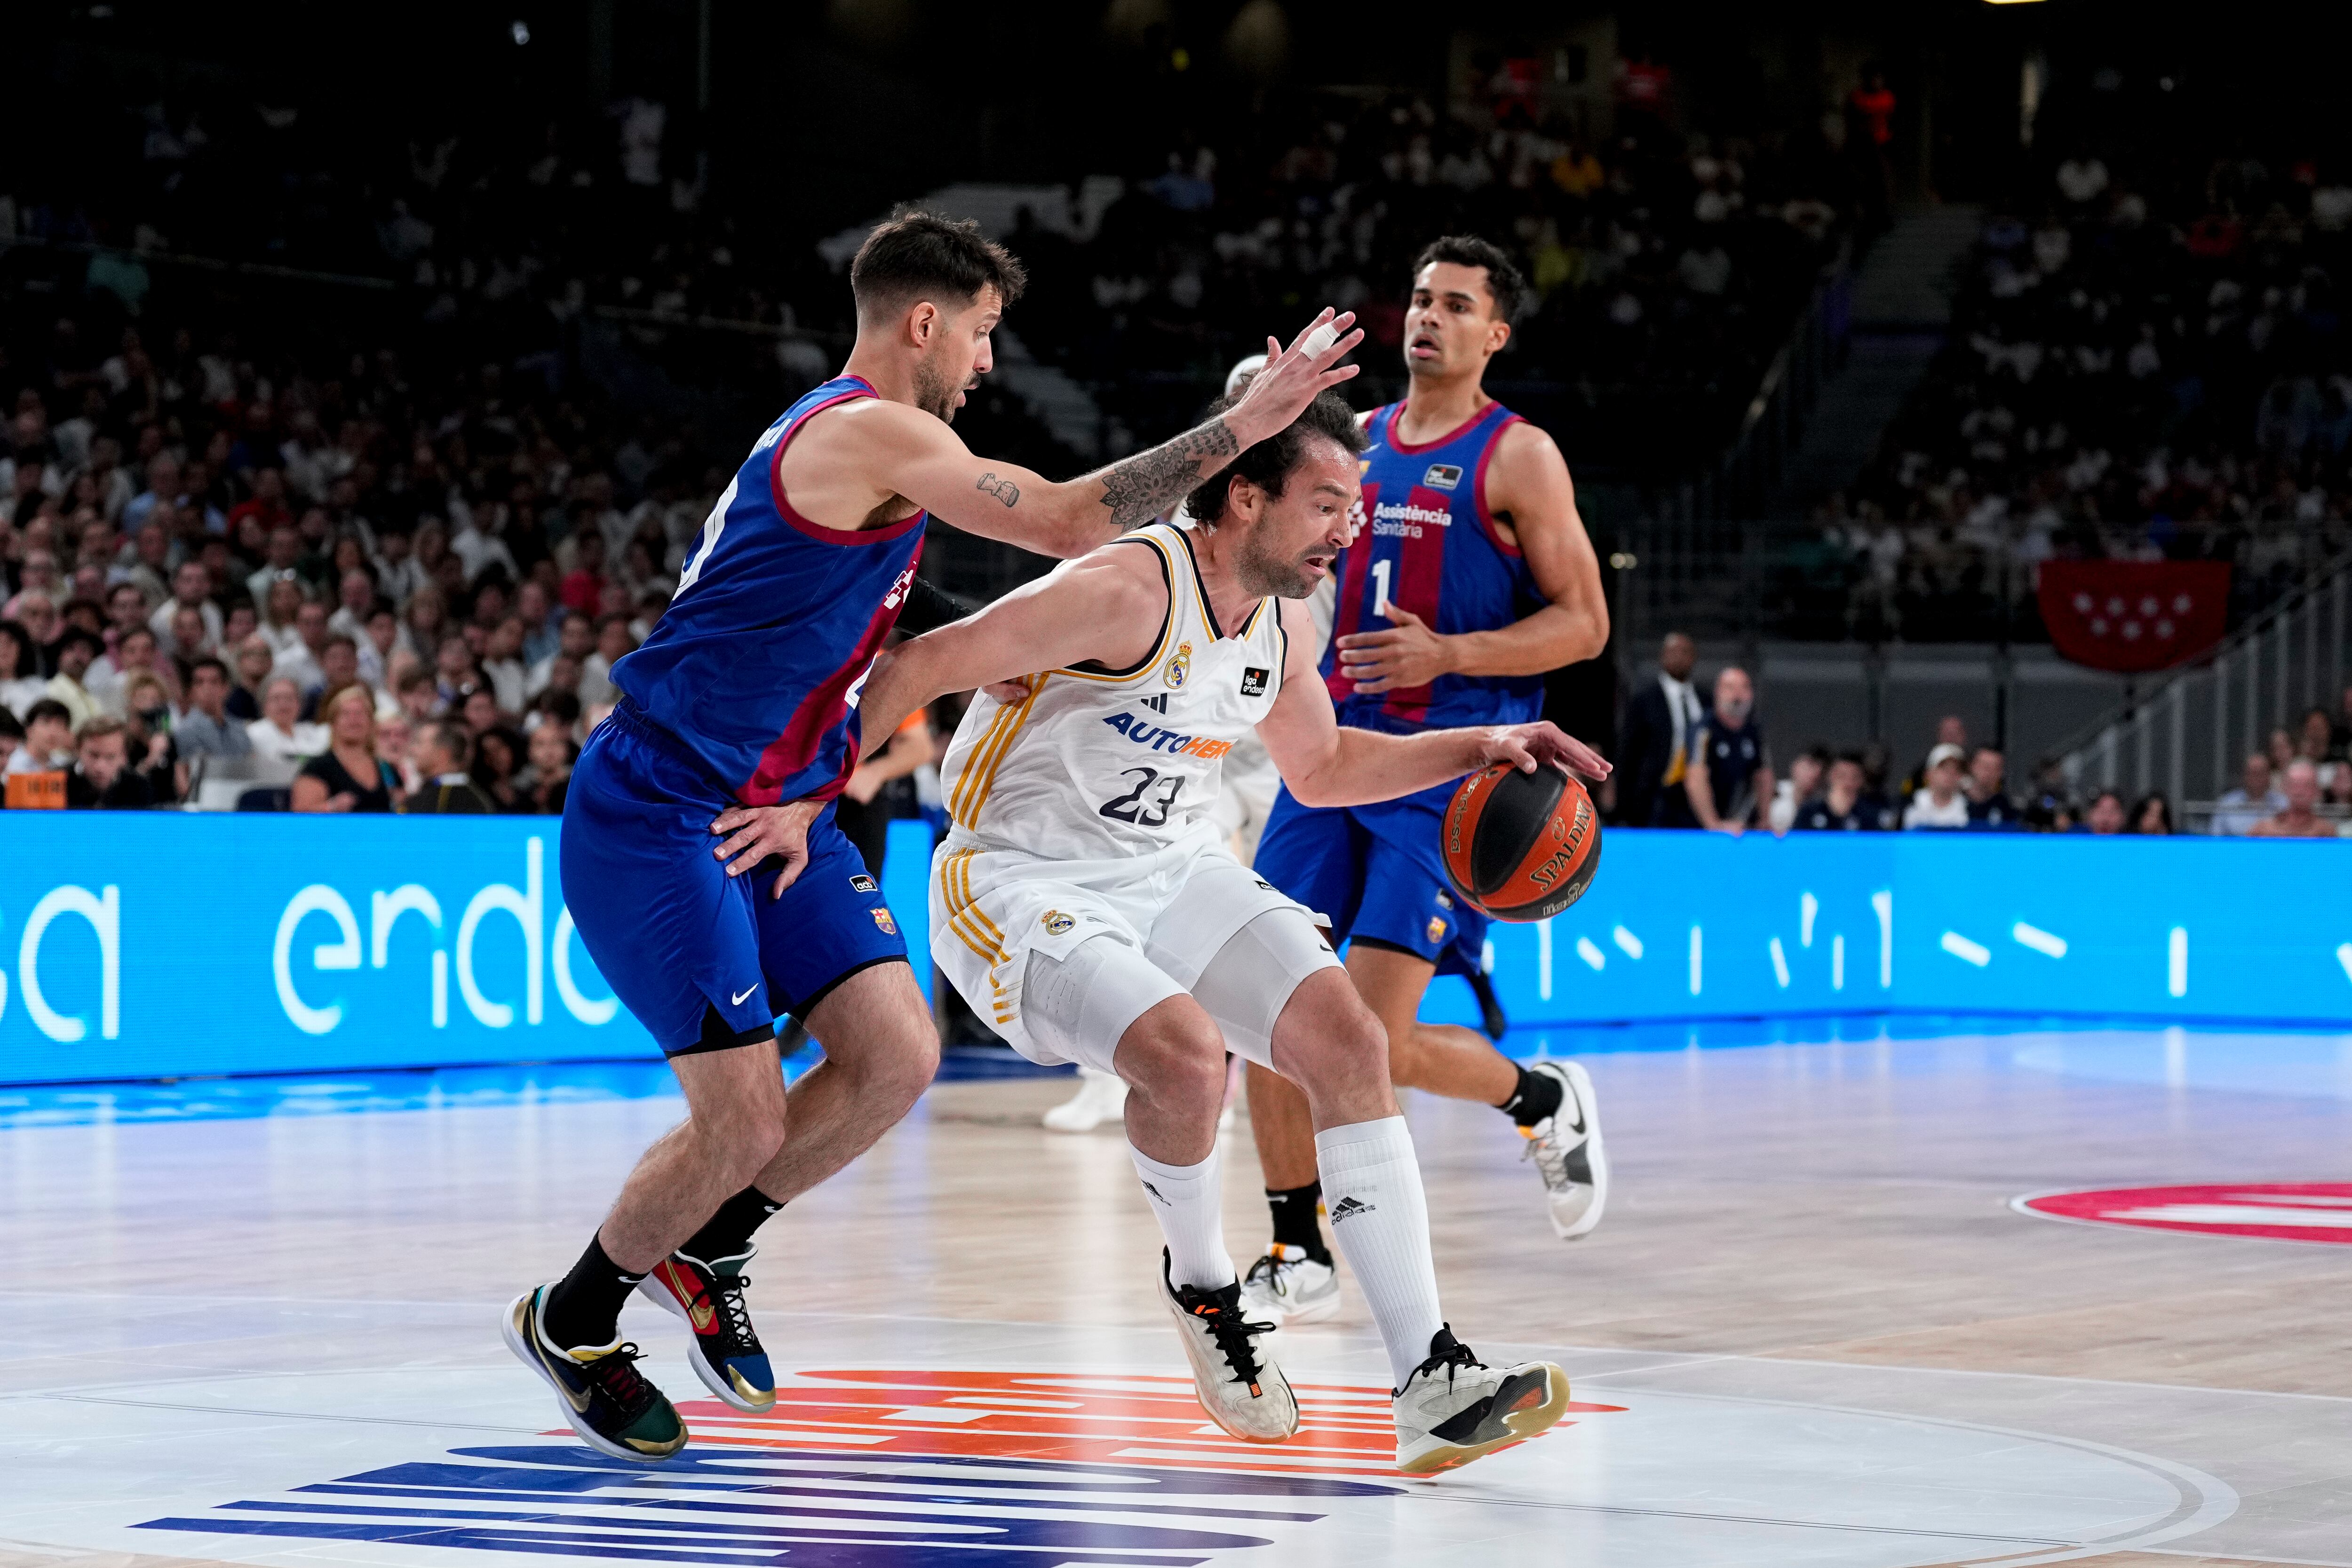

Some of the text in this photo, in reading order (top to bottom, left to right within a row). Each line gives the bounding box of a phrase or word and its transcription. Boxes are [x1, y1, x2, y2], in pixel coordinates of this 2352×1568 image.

[1373, 502, 1452, 526] Assistència
[1372, 559, 1391, 616] 1
[1243, 685, 1264, 694] endesa
[1245, 675, 1257, 685] liga
[1099, 767, 1186, 827] 23
[1530, 793, 1594, 892] SPALDING
[857, 880, 873, 890] acb
[0, 883, 120, 1043] a
[1331, 1205, 1376, 1226] adidas
